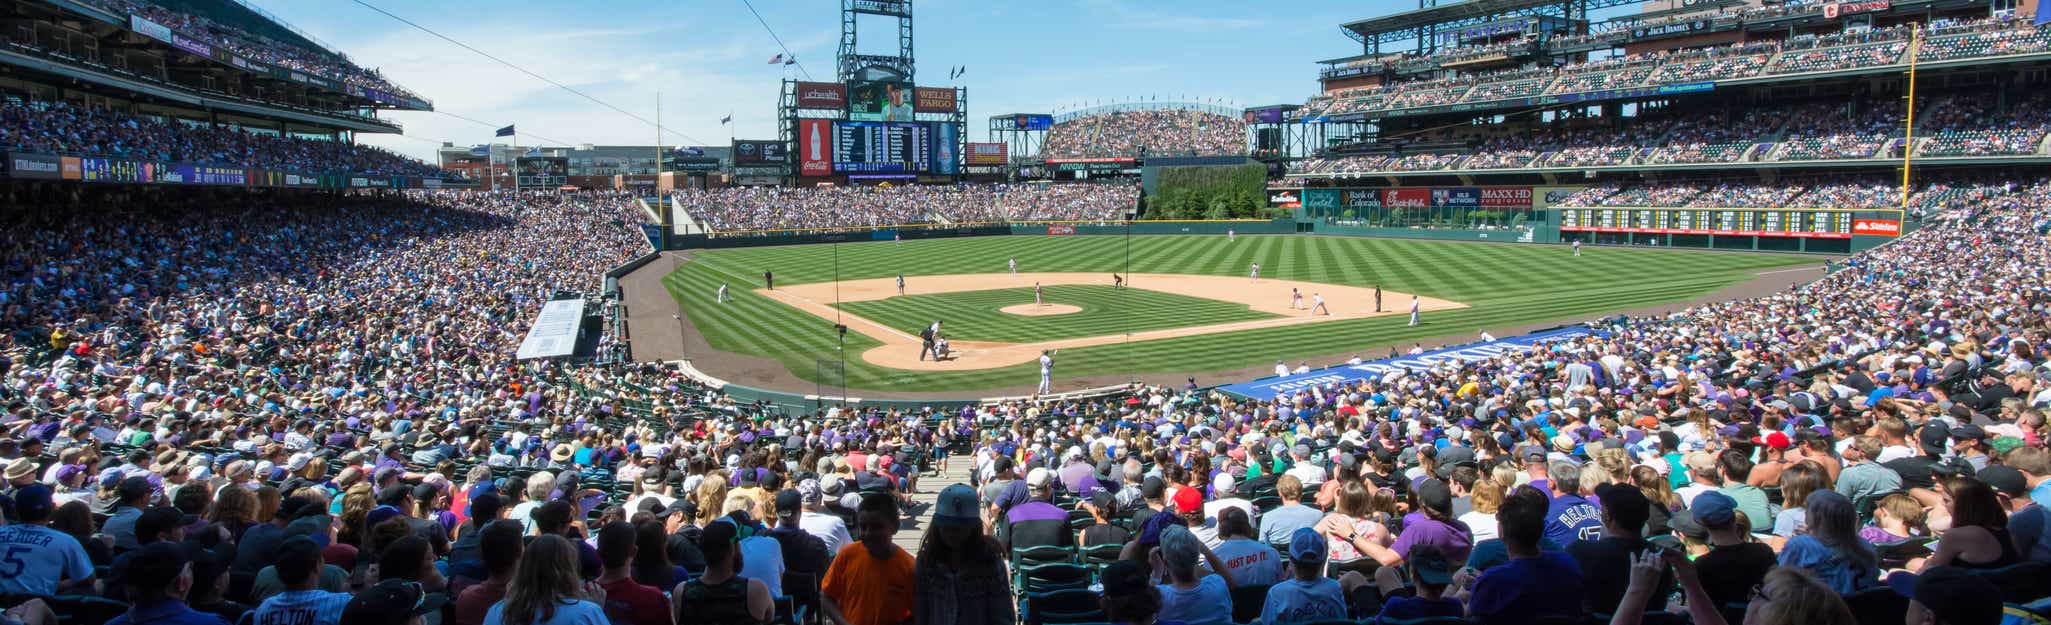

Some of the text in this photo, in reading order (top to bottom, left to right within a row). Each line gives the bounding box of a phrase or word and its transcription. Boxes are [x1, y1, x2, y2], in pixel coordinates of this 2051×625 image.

[920, 91, 951, 100] WELLS
[920, 99, 951, 108] FARGO
[1350, 190, 1375, 199] Bank of
[1481, 190, 1532, 199] MAXX HD
[1349, 199, 1381, 207] Colorado
[0, 545, 32, 579] 5
[1227, 556, 1244, 568] JUST
[1246, 553, 1257, 564] DO
[260, 607, 318, 625] HELTON
